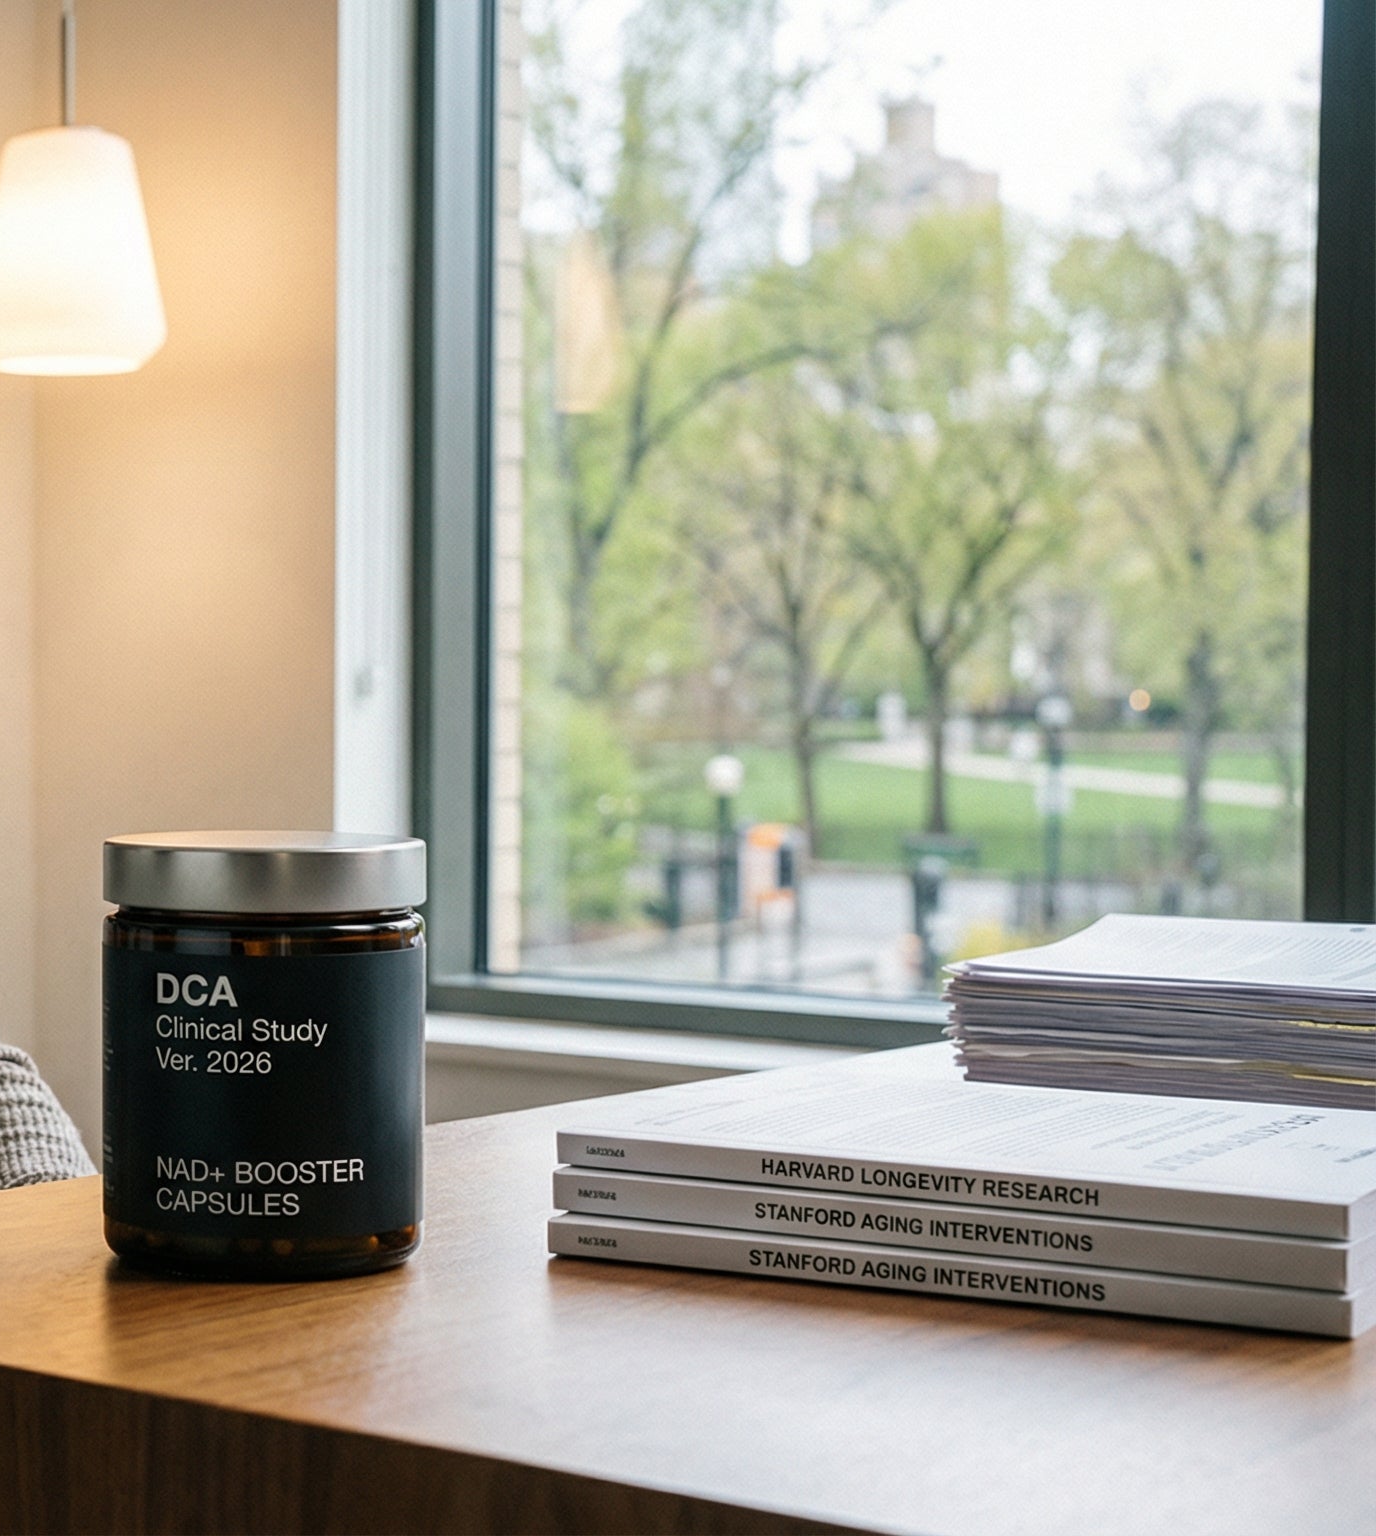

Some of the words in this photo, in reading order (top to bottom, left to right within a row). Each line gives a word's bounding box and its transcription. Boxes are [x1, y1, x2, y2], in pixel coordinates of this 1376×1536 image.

[156, 972, 238, 1008] DCA
[156, 1014, 243, 1042] Clinical
[251, 1018, 329, 1048] Study
[155, 1046, 199, 1073] Ver.
[206, 1050, 273, 1075] 2026
[156, 1156, 226, 1183] NAD+
[235, 1158, 365, 1185] BOOSTER
[761, 1158, 855, 1183] HARVARD
[861, 1167, 977, 1194] LONGEVITY
[982, 1179, 1099, 1207] RESEARCH
[156, 1187, 301, 1217] CAPSULES
[754, 1202, 856, 1228] STANFORD
[860, 1214, 924, 1236] AGING
[929, 1220, 1094, 1252] INTERVENTIONS
[749, 1249, 856, 1275] STANFORD
[861, 1261, 927, 1284] AGING
[933, 1267, 1107, 1302] INTERVENTIONS
